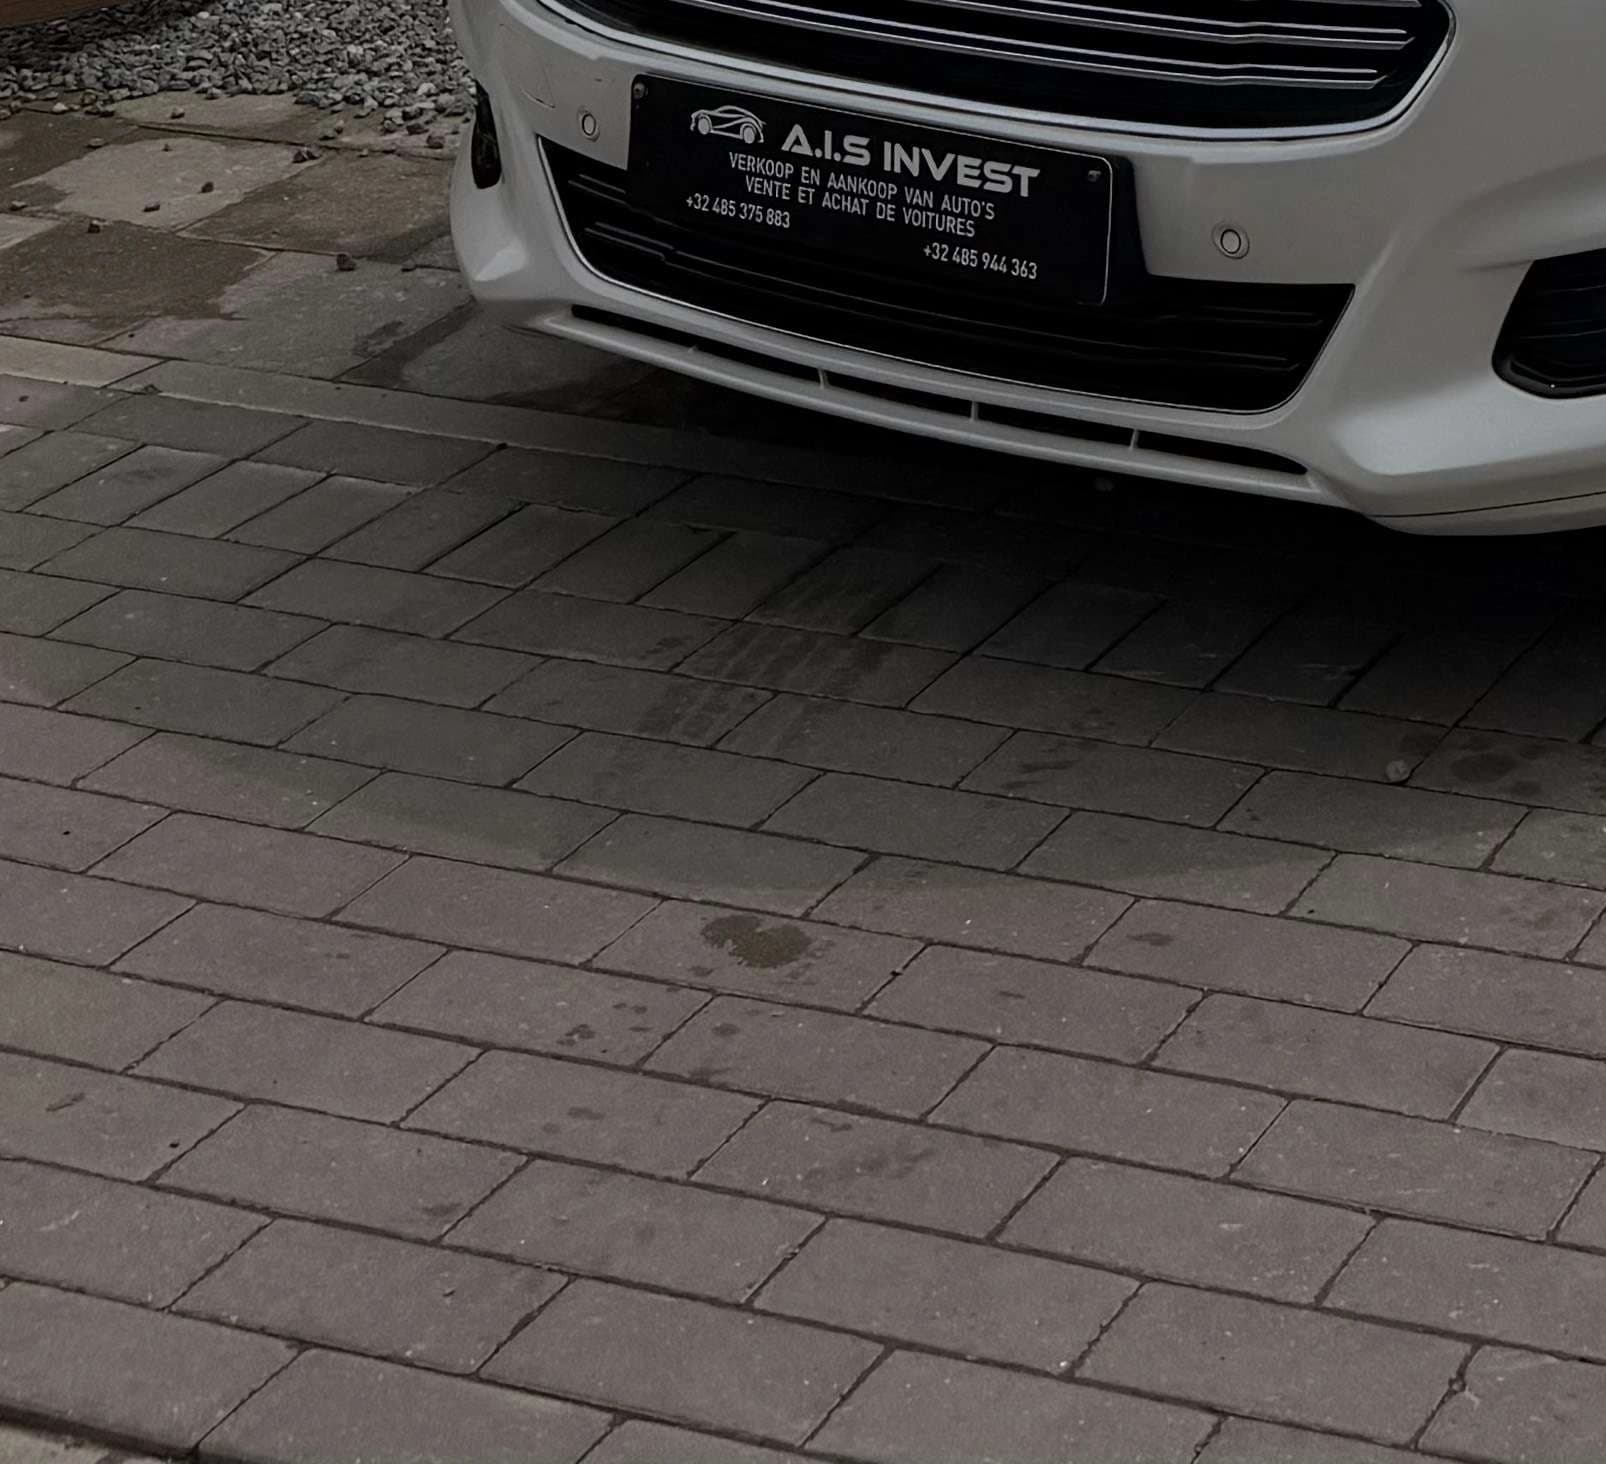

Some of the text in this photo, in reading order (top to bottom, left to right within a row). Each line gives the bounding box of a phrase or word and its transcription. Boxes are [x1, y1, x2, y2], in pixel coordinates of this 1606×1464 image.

[729, 151, 996, 221] VERKOOP EN AANKOOP VAN AUTO'S
[780, 123, 1041, 198] A.I.S INVEST
[686, 193, 791, 229] +32 485 375 883
[745, 174, 976, 238] VENTE ET ACHAT DE VOITURES
[923, 242, 1038, 280] +32 485 944 363
